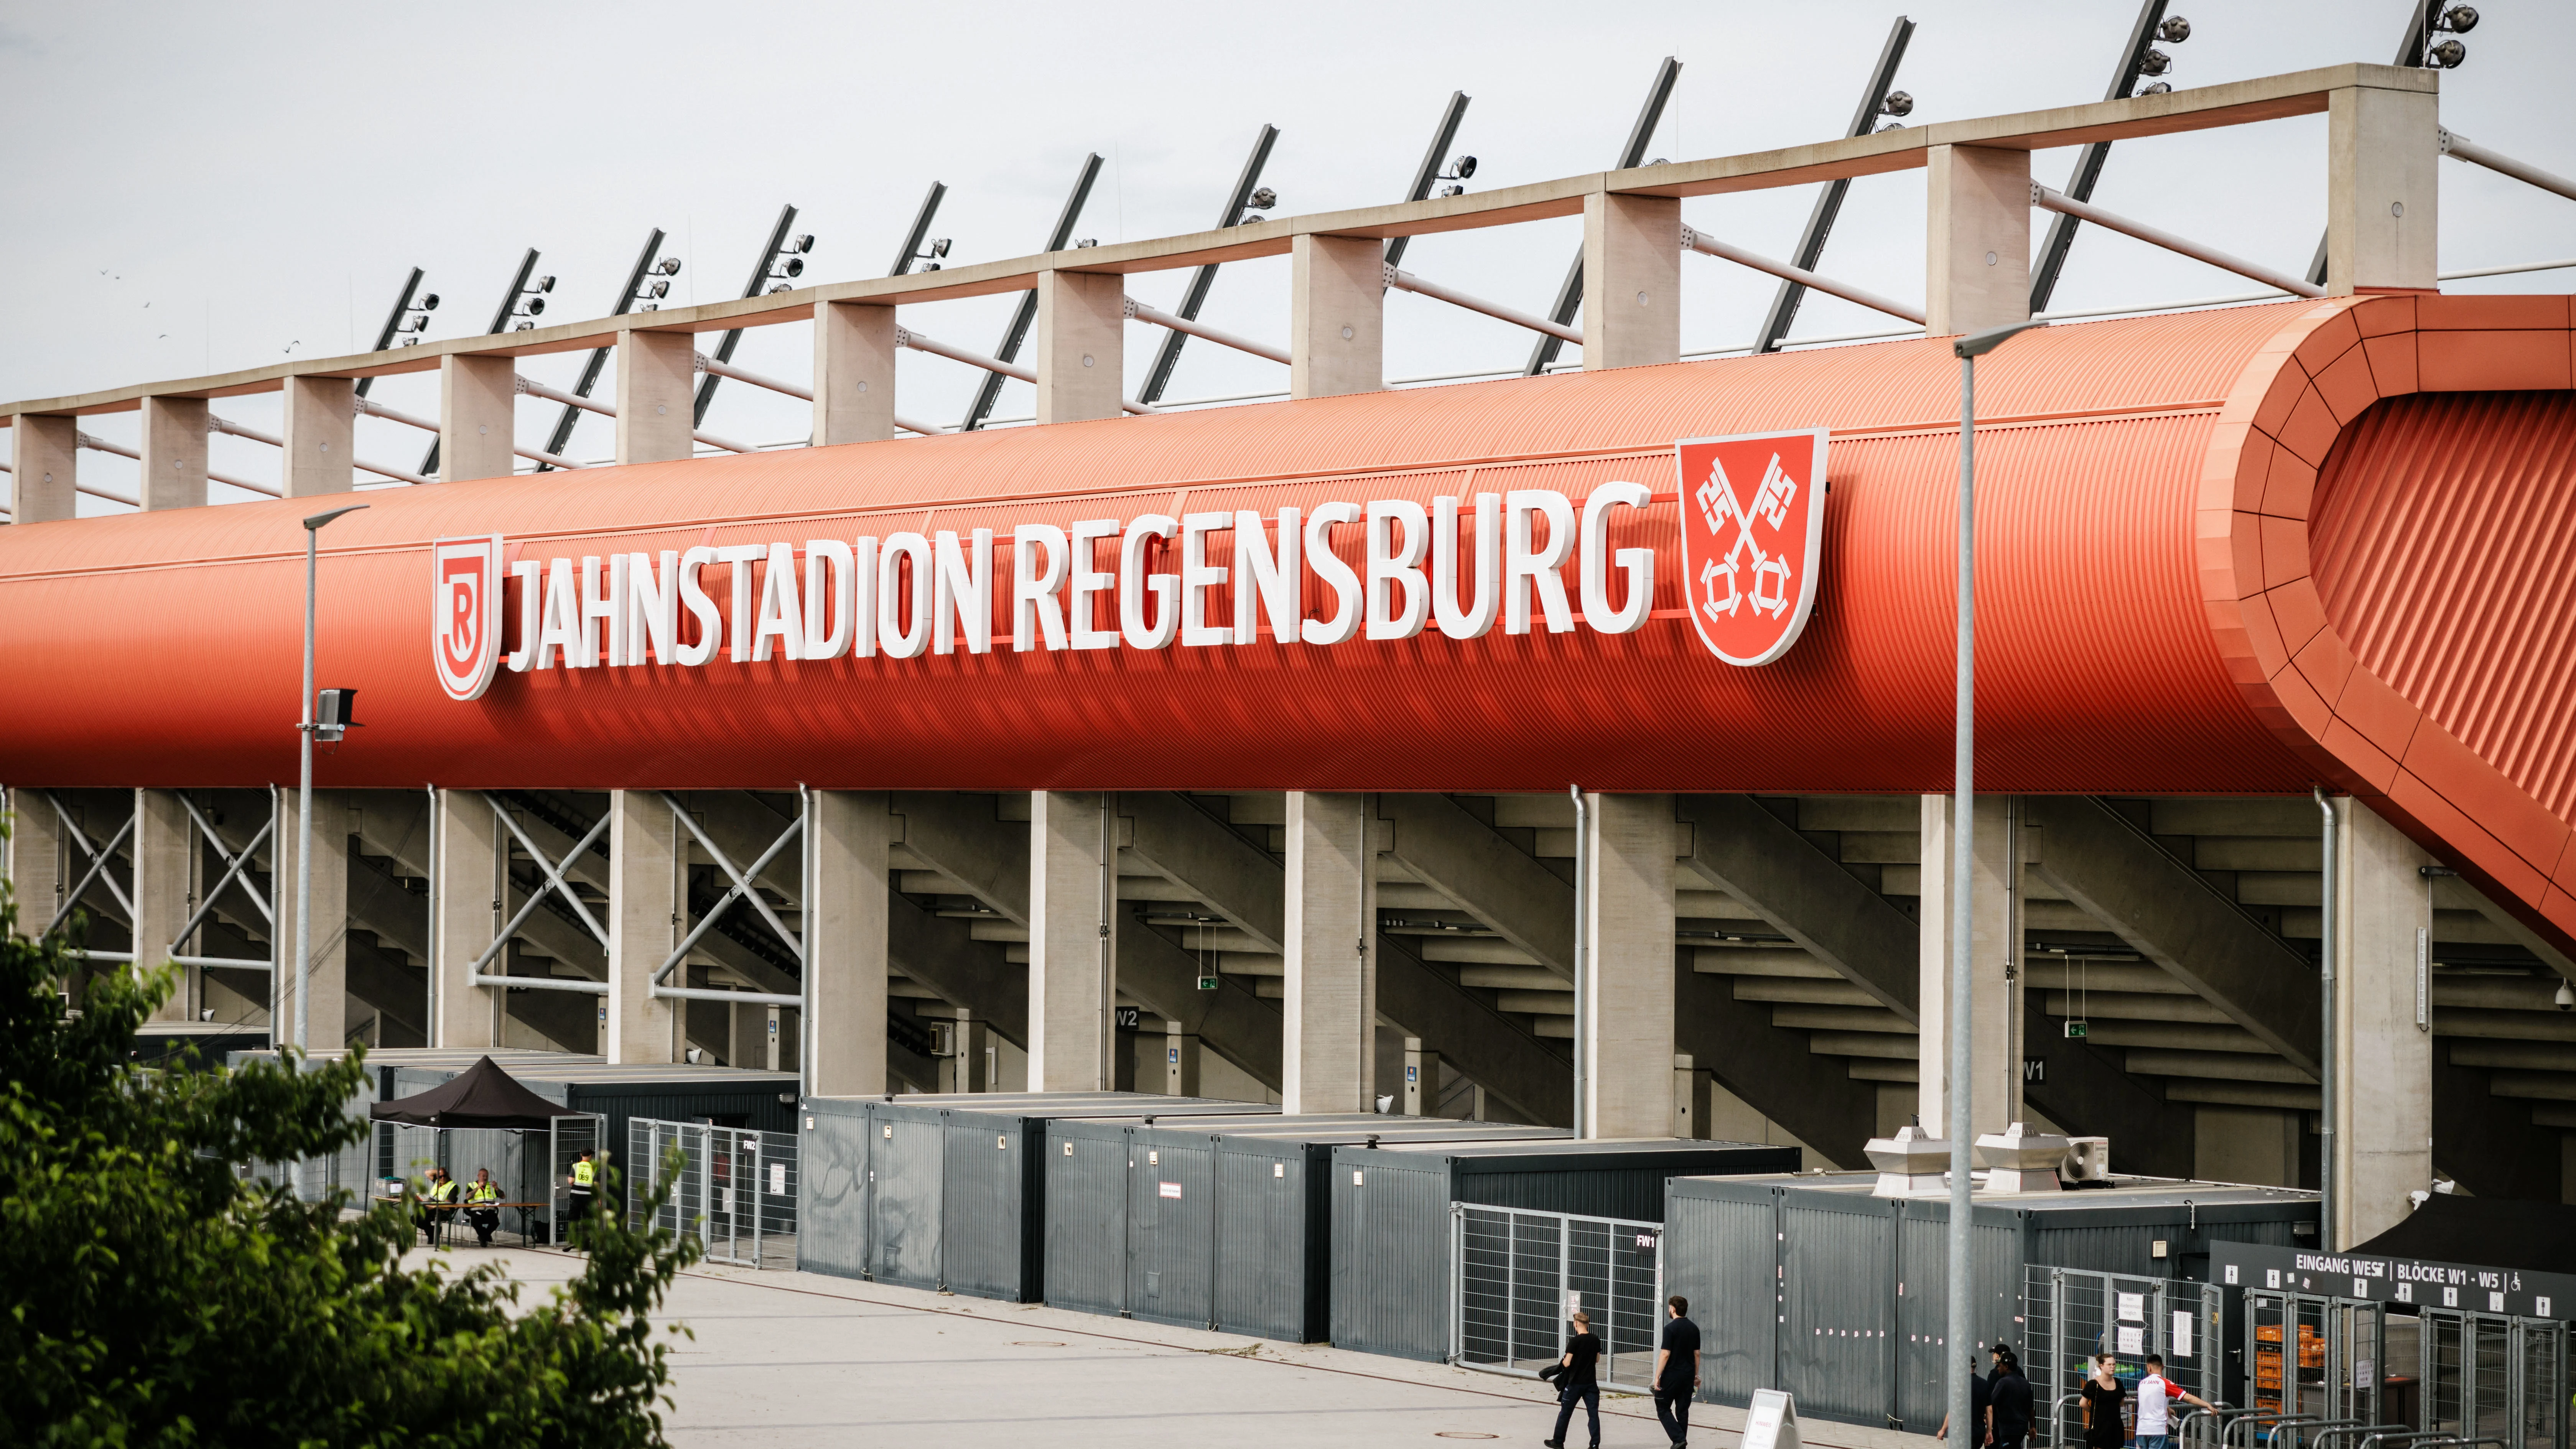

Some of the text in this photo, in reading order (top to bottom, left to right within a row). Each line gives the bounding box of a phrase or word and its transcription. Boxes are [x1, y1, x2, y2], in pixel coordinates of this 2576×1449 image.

[508, 481, 1654, 672] JAHNSTADION REGENSBURG
[744, 1140, 756, 1150] FW2
[1637, 1235, 1654, 1247] FW1
[2296, 1254, 2349, 1274] EINGANG
[2352, 1260, 2385, 1277] WEST
[2398, 1261, 2444, 1283] BLÖCKE
[2448, 1269, 2466, 1285] W1
[2479, 1272, 2499, 1288] W5
